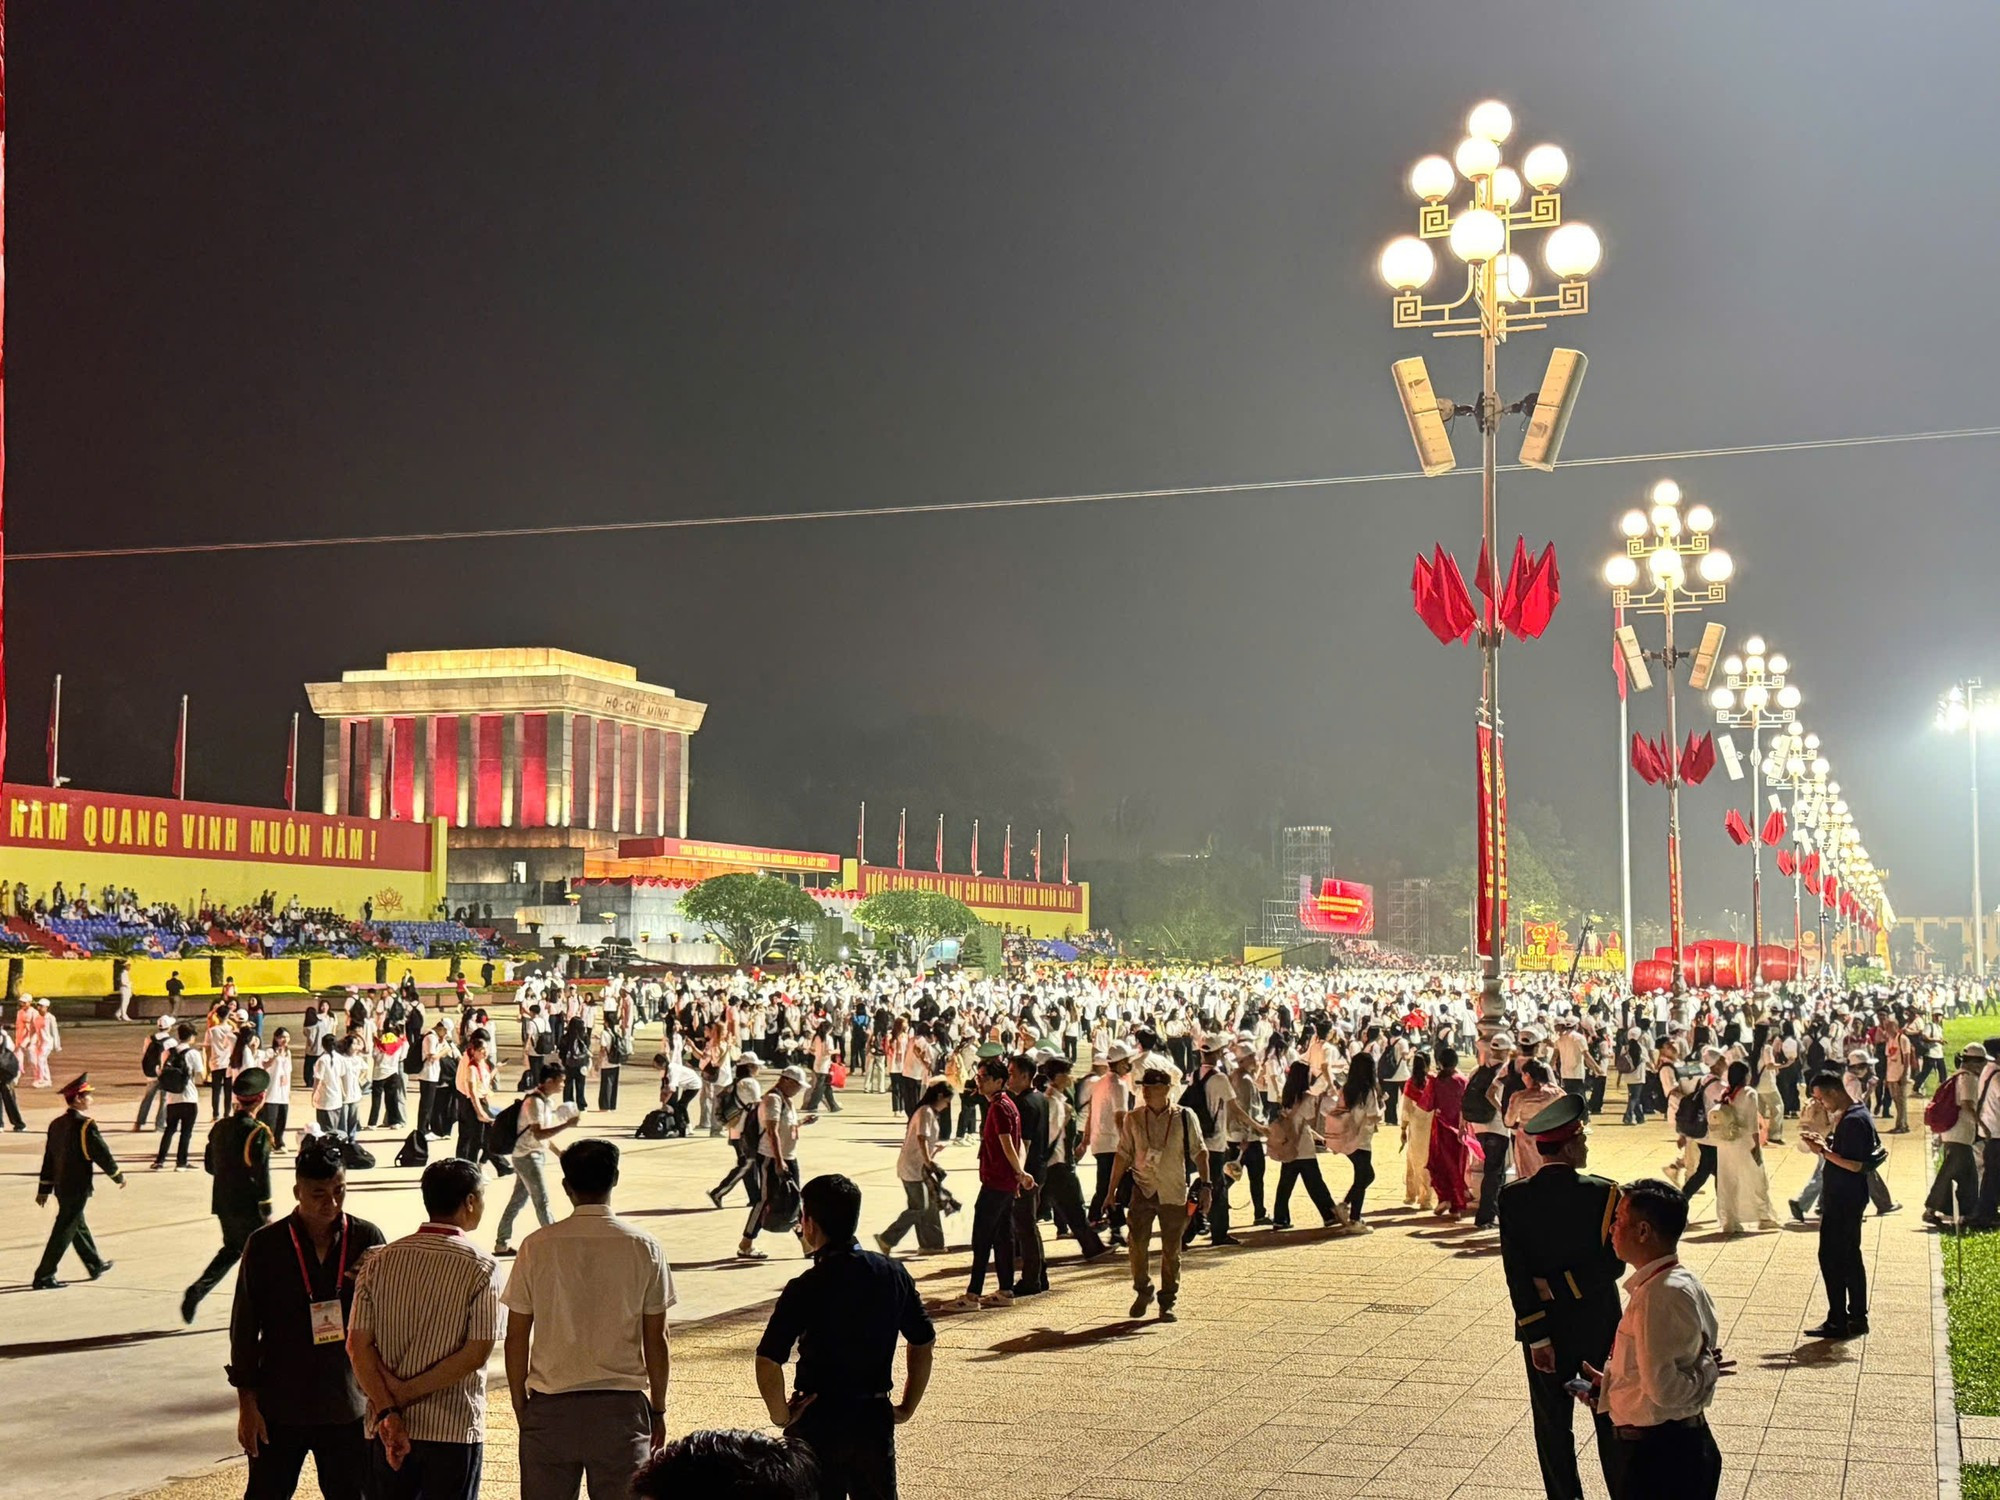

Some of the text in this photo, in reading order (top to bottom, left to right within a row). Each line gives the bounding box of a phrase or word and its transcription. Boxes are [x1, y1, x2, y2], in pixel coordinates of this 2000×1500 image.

[10, 799, 68, 841] NAM
[83, 805, 168, 847] QUANG
[181, 813, 238, 852] VINH
[250, 817, 311, 857] MUÔN
[1024, 886, 1037, 906] NAM
